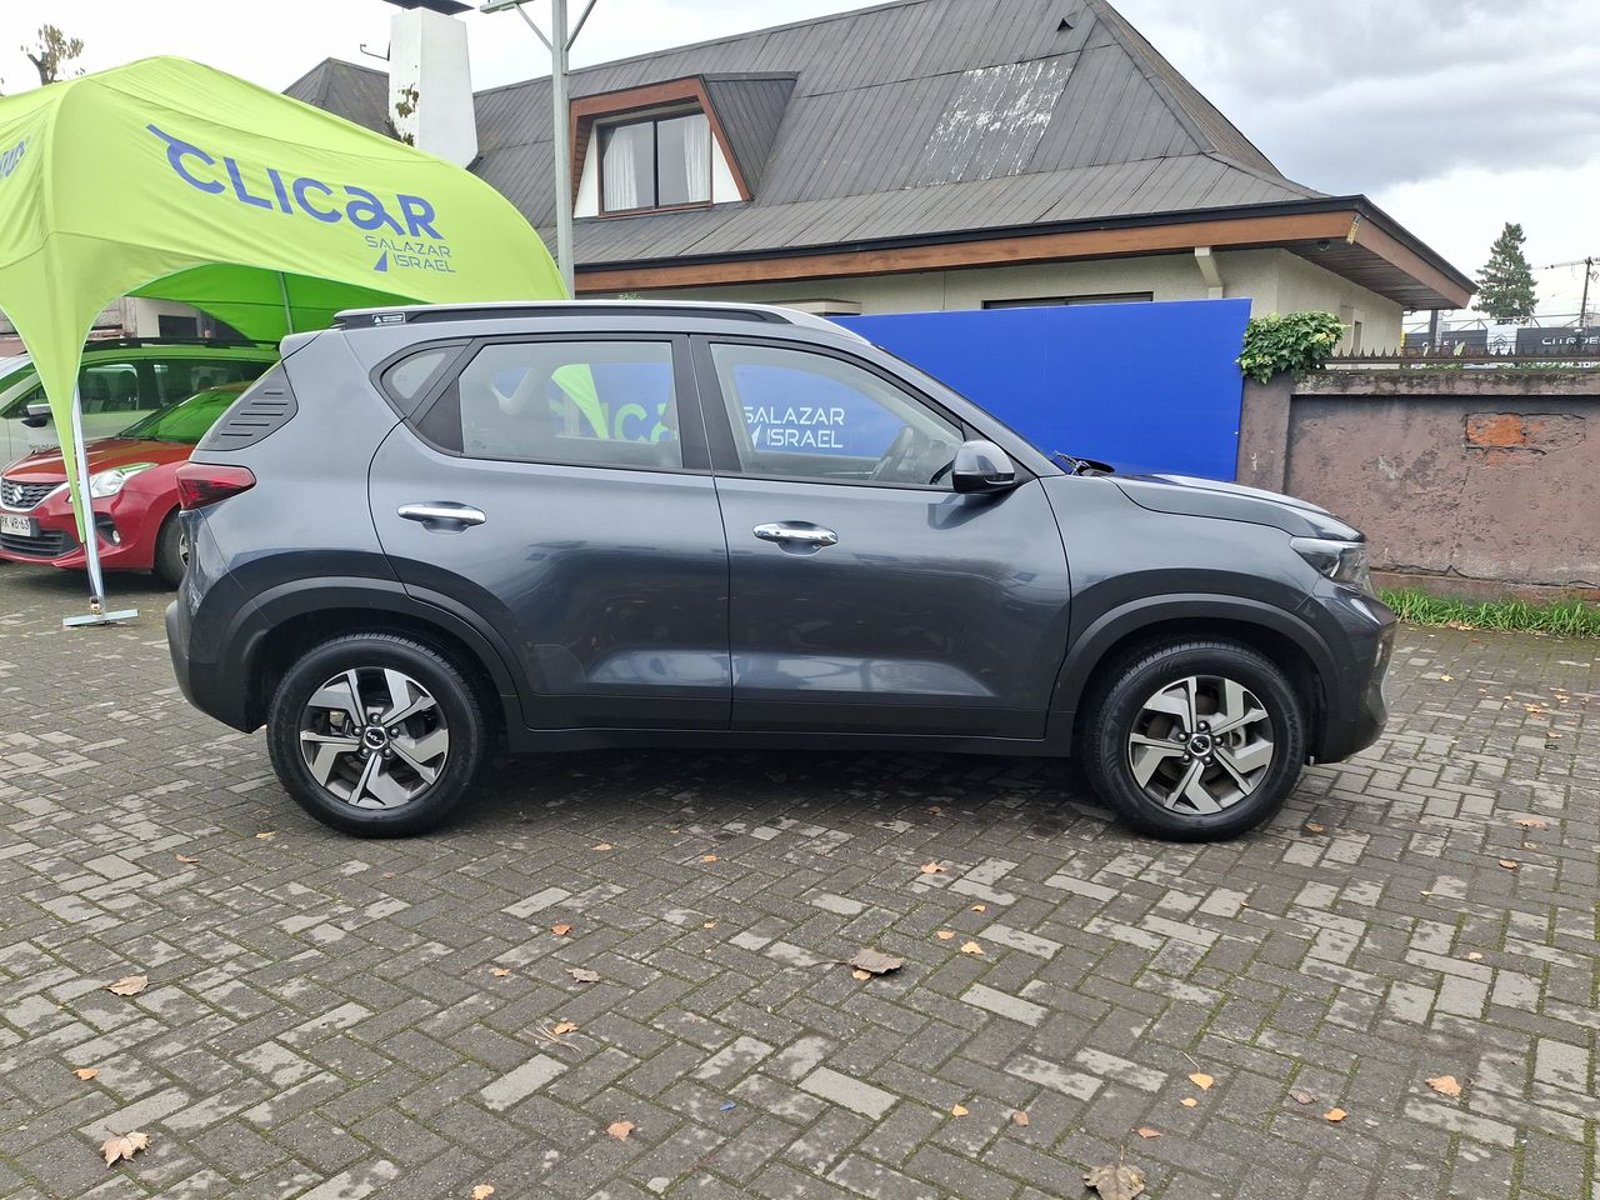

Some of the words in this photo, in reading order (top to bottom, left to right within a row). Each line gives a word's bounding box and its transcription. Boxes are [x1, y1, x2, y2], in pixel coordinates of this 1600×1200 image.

[364, 235, 452, 258] SALAZAR
[393, 254, 456, 273] ISRAEL
[743, 406, 845, 426] SALAZAR
[767, 428, 843, 448] ISRAEL
